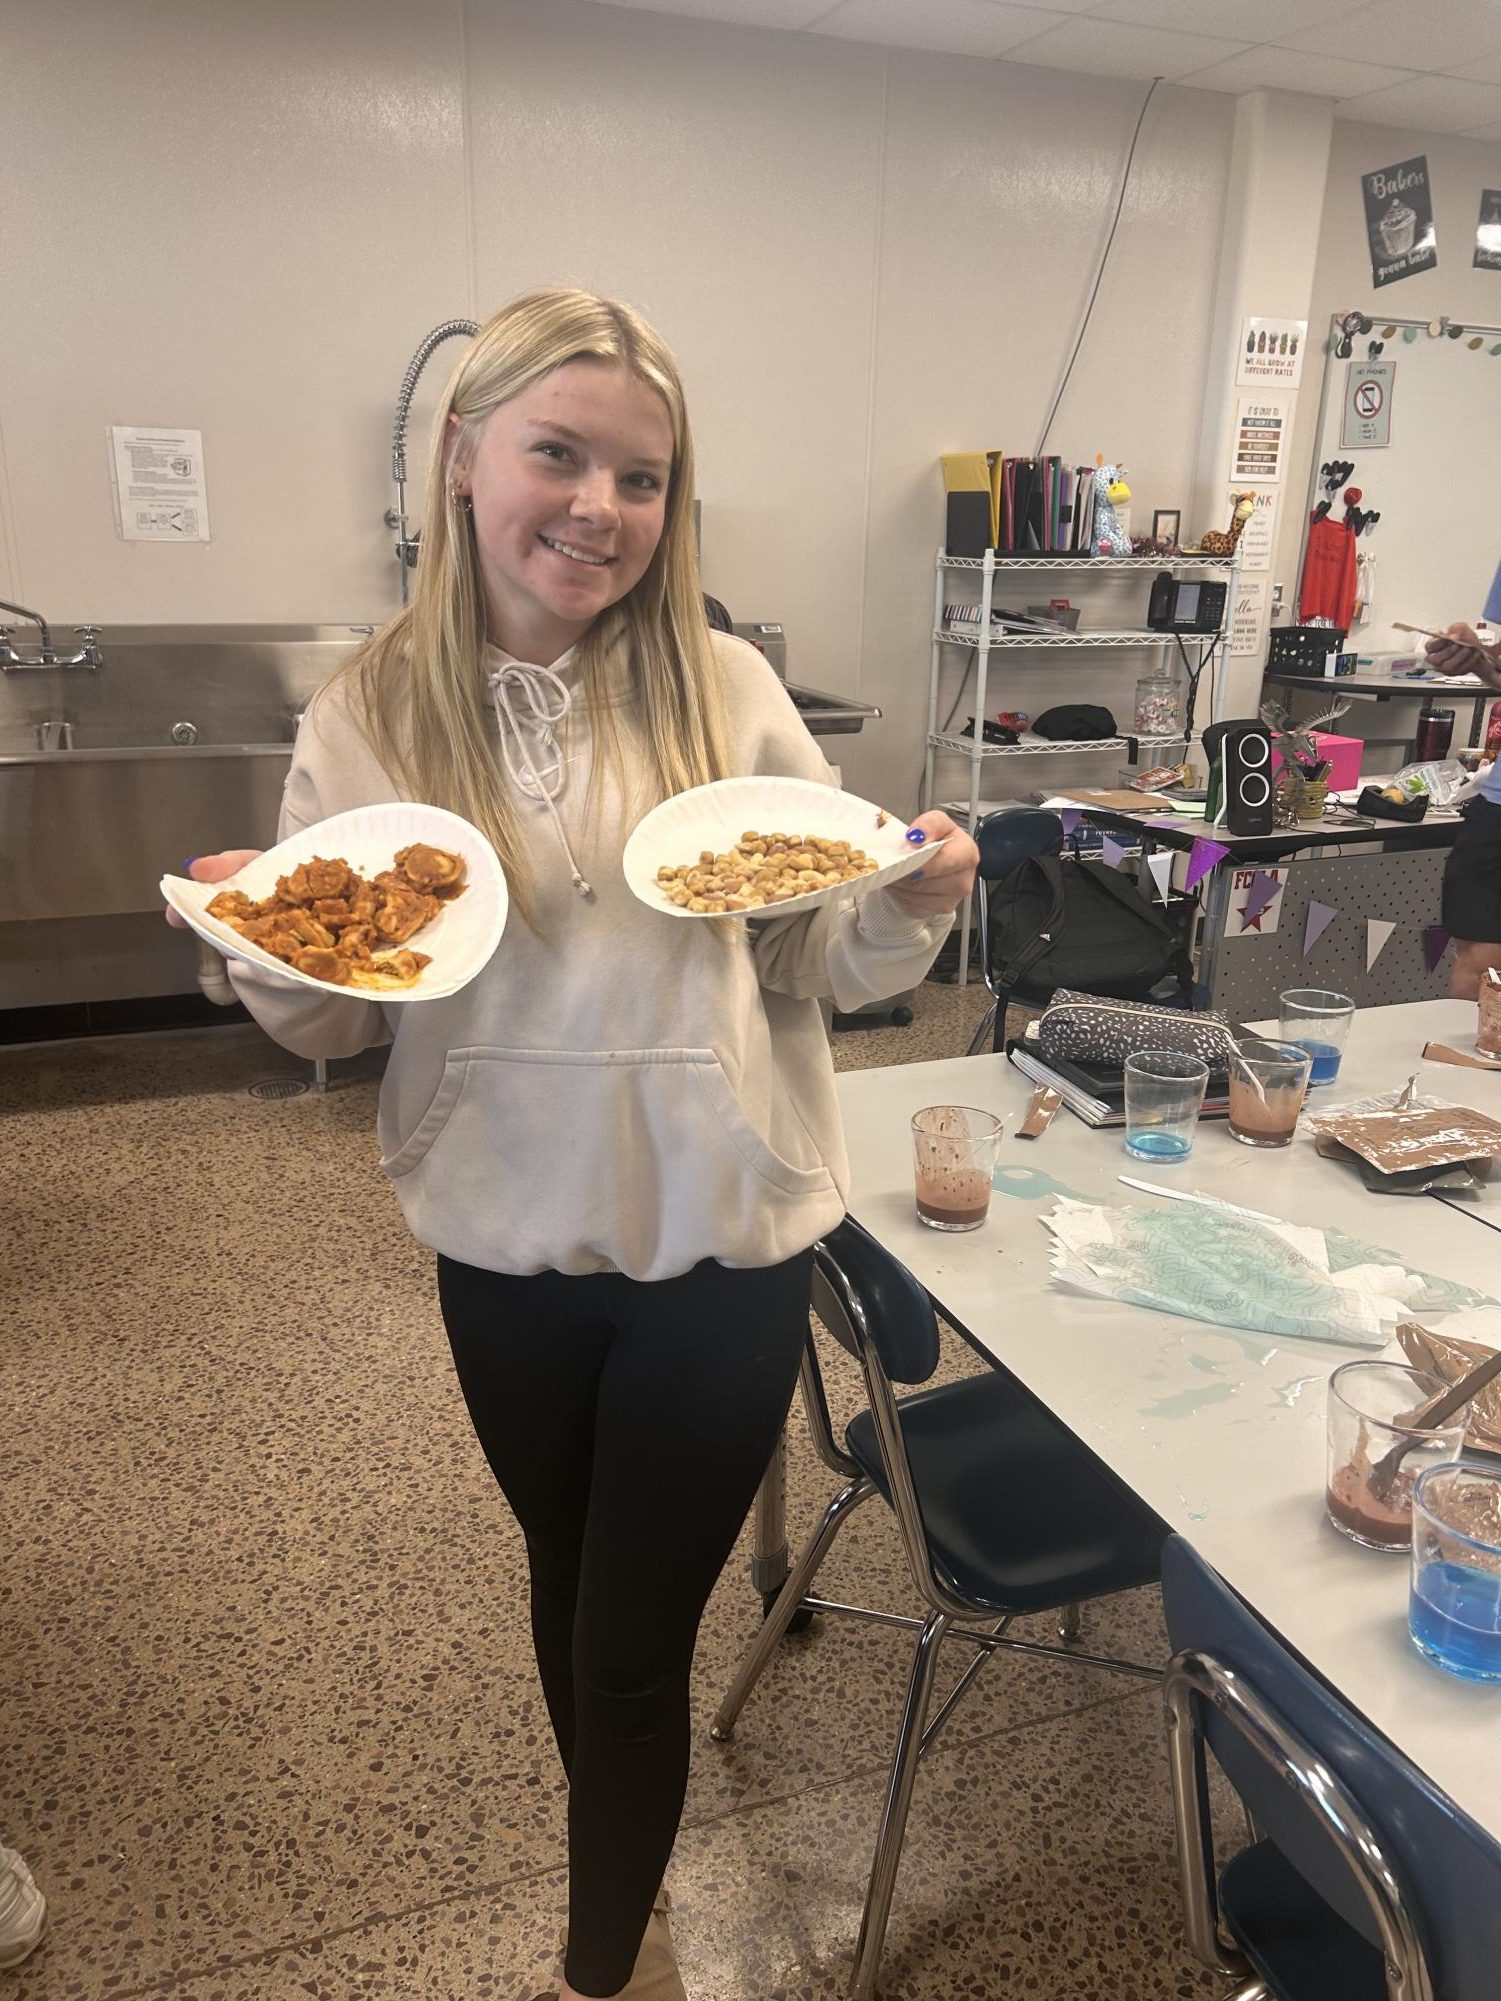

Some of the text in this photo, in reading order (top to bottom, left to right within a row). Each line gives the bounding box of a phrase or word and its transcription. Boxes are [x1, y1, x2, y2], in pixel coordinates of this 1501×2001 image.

[1245, 357, 1296, 368] WE ALL GROW AT
[1244, 366, 1293, 377] DIFFERENT RATES
